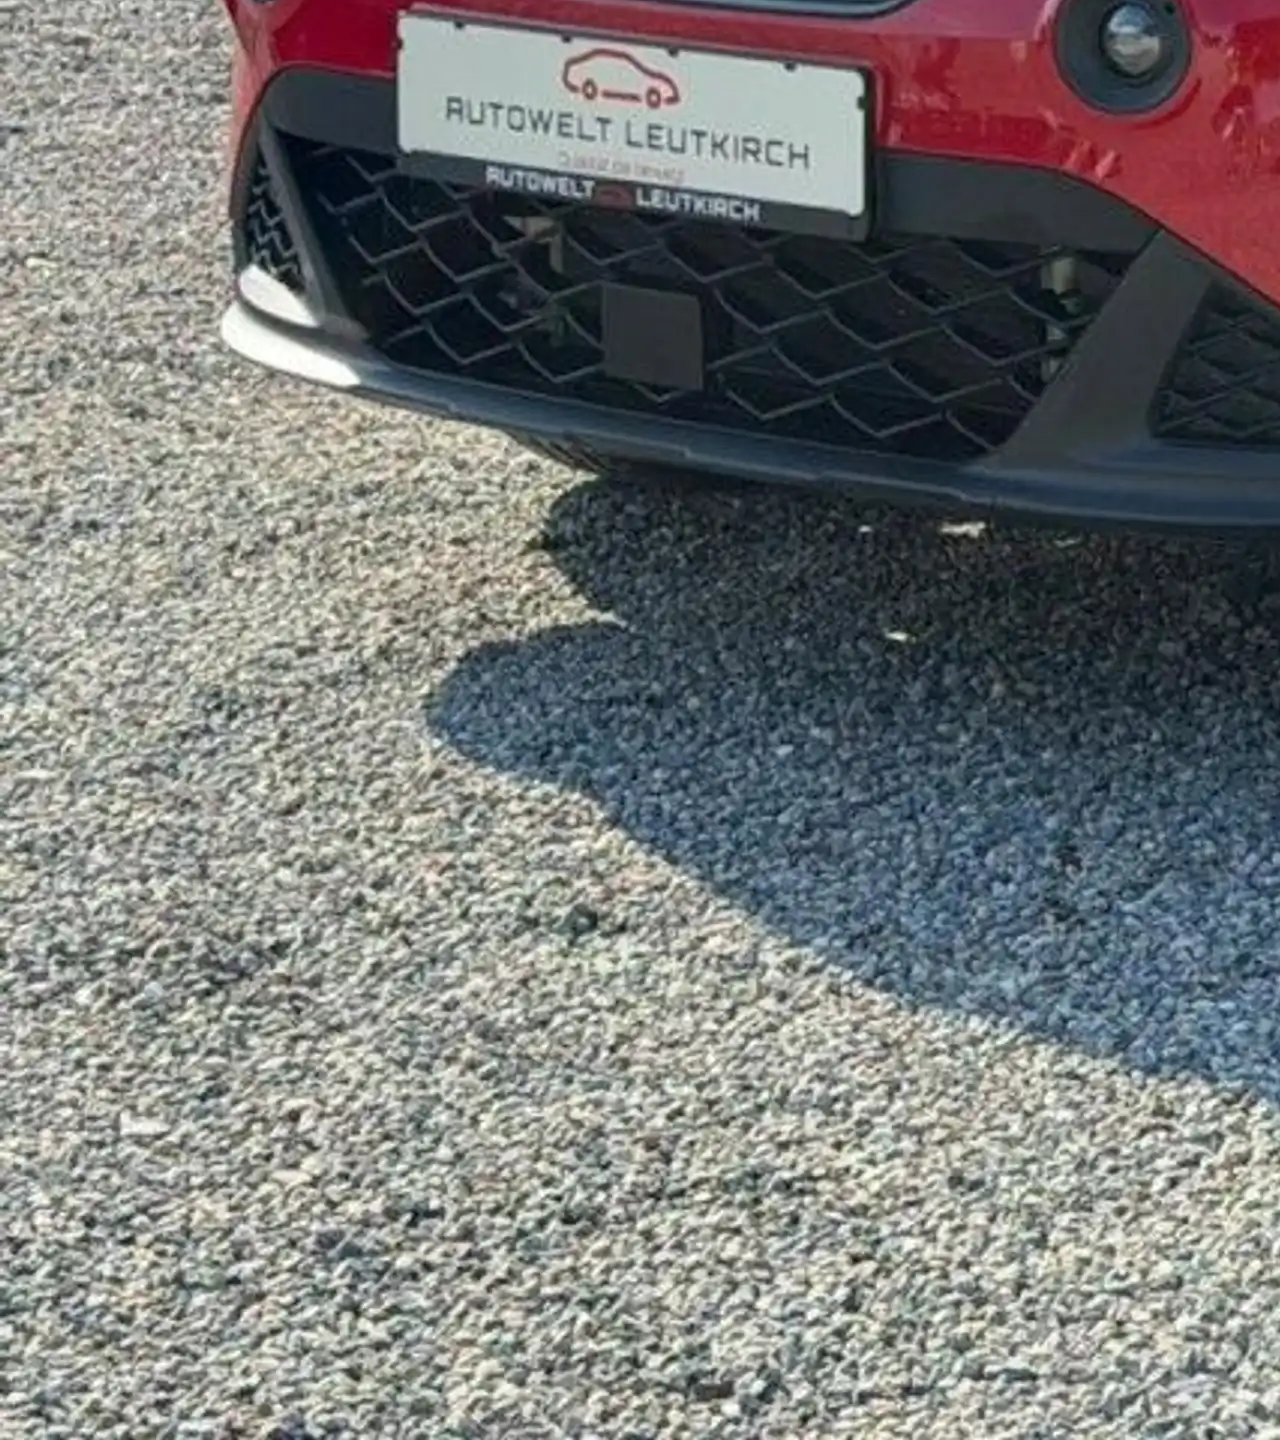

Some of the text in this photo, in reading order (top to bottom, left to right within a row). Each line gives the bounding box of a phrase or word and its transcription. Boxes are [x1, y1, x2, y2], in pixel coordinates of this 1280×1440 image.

[445, 96, 612, 143] AUTOWELT
[625, 120, 811, 169] LEUTKIRCH
[485, 165, 596, 200] AUTOWELT
[635, 186, 761, 223] LEUTKIRCH
